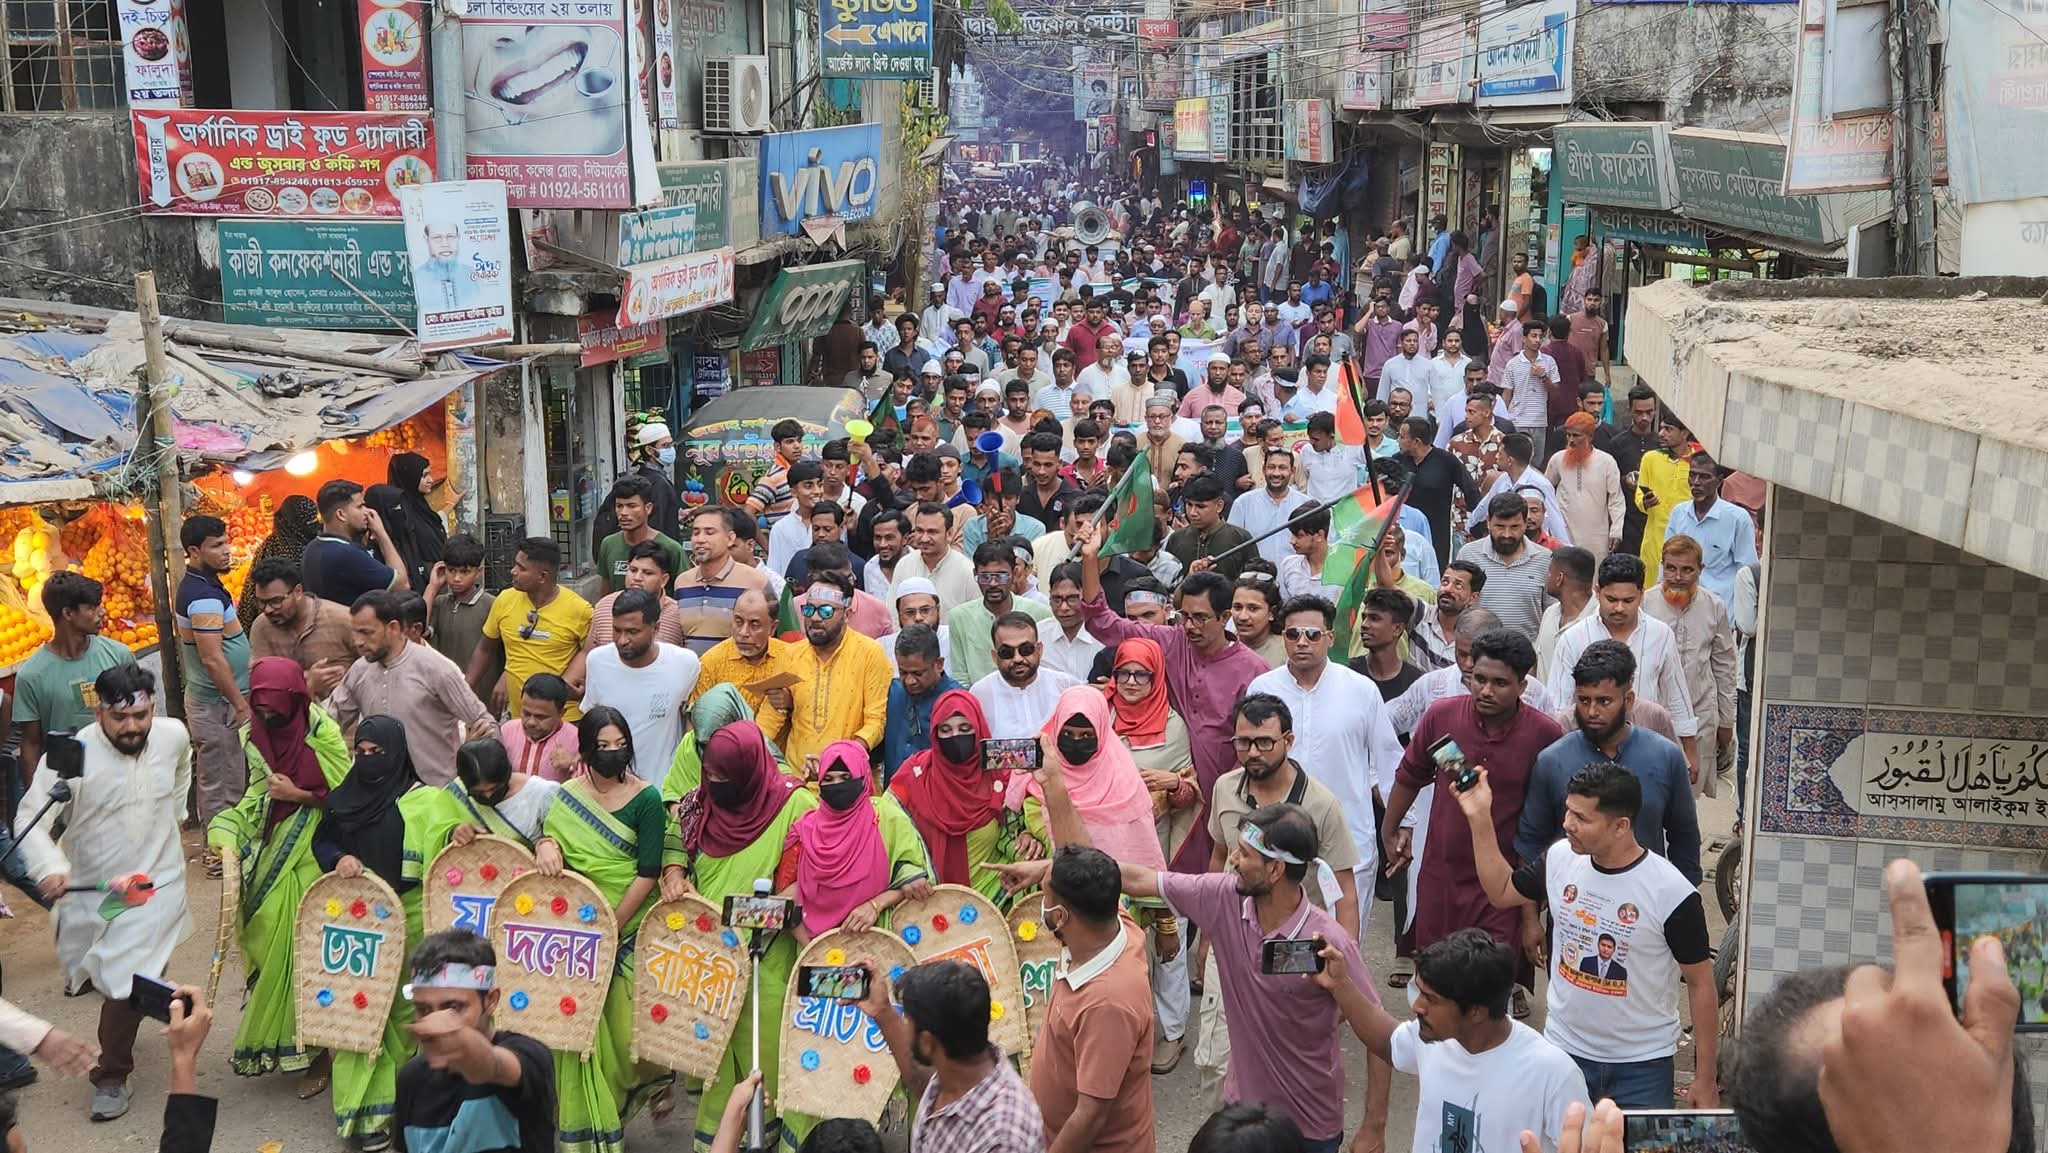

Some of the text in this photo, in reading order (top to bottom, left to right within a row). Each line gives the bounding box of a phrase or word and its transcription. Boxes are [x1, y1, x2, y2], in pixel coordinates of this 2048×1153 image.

[551, 3, 569, 16] ২য়
[575, 3, 612, 16] তলায়
[1084, 10, 1137, 33] সেন্টা
[877, 19, 928, 44] এখানে
[175, 115, 428, 155] অর্গানিক ড্রাই ফুড গ্যালারী
[229, 156, 254, 171] এন্ড
[256, 155, 306, 176] জুসবার
[309, 157, 322, 171] ও
[325, 153, 356, 172] কফি
[467, 165, 485, 179] কার
[487, 161, 523, 180] টাওয়ার,
[526, 165, 554, 179] কলেজ
[584, 161, 628, 178] নিউমার্কেট
[1597, 140, 1655, 187] ফার্মেসী
[529, 184, 537, 197] #
[539, 182, 626, 200] 01924-561111
[770, 147, 876, 221] vivo
[1680, 166, 1720, 192] নুসরাত
[226, 237, 263, 280] কাজী
[266, 238, 361, 280] কনফেকশনারী
[367, 250, 393, 279] এন্ড
[1952, 795, 2029, 820] আলাইকুম
[320, 922, 384, 978] তম
[501, 922, 602, 982] দলের
[646, 938, 739, 1021] বার্ষিকী
